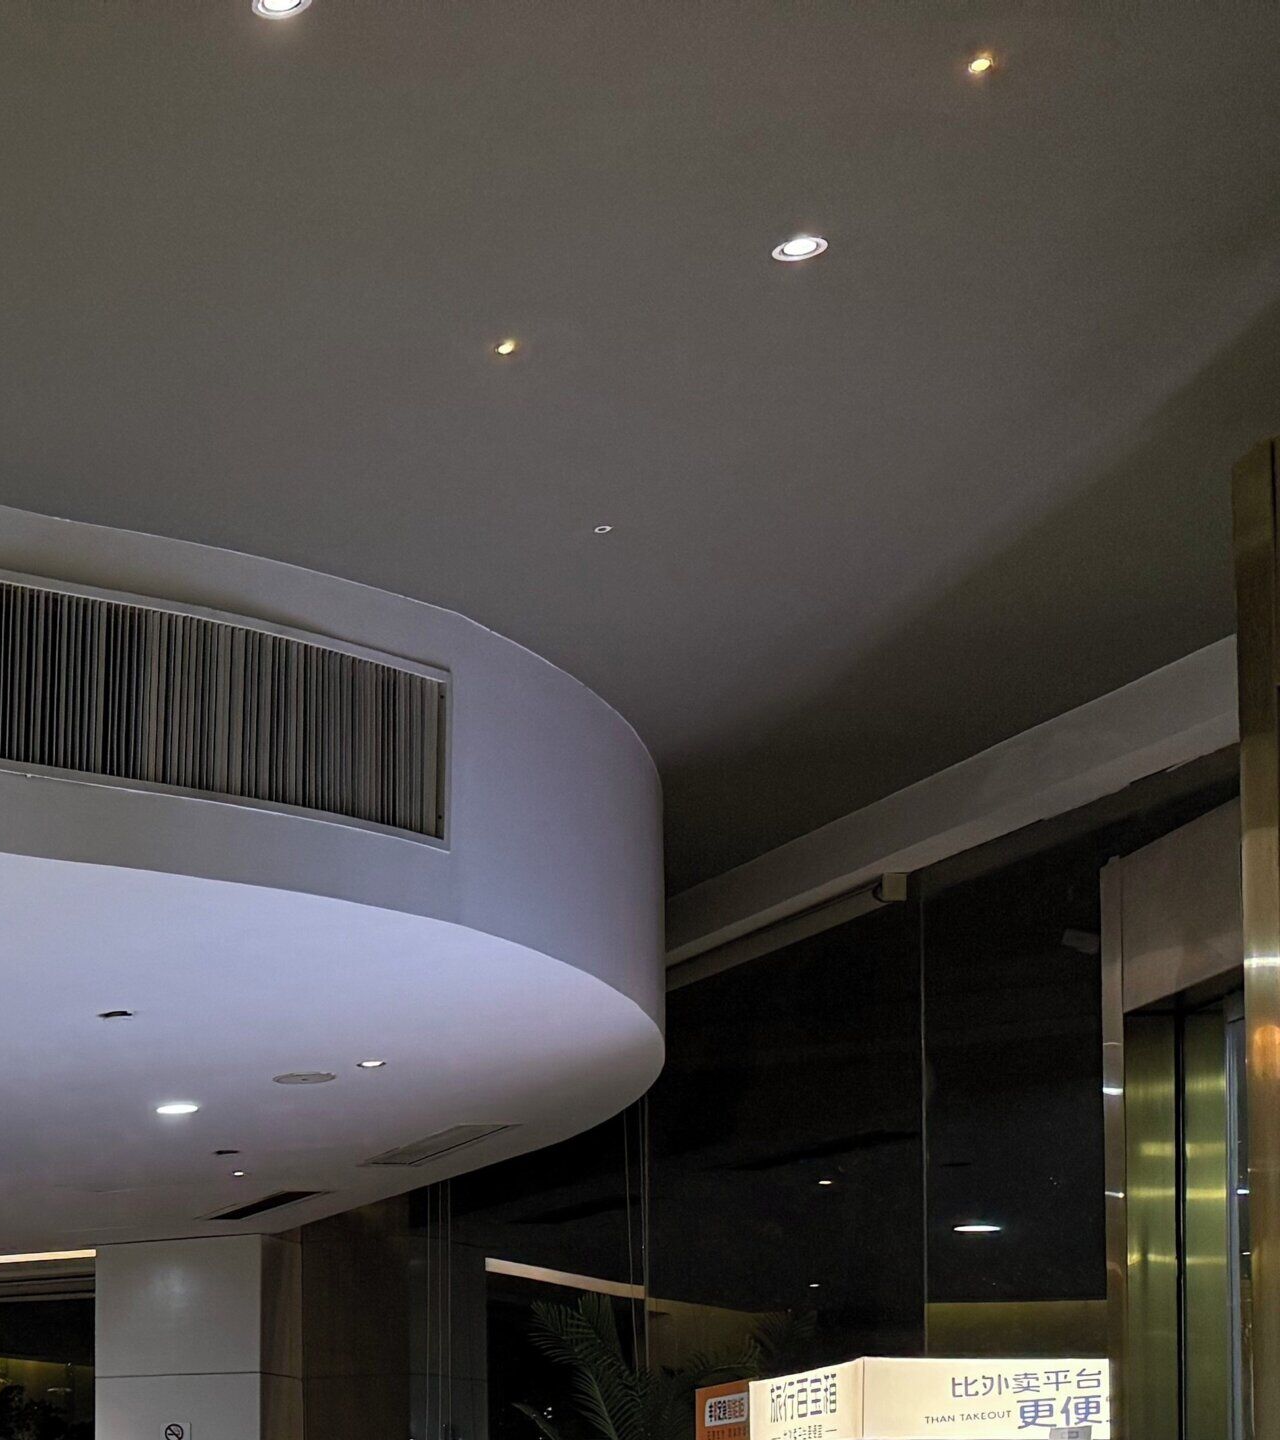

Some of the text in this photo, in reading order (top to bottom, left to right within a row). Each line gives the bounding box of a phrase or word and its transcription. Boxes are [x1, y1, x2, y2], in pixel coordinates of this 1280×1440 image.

[770, 1373, 837, 1423] 旅行百宝箱
[951, 1368, 1102, 1397] 比外卖平台
[924, 1410, 1012, 1425] THAN TAKEOUT
[1016, 1395, 1111, 1430] 更便
